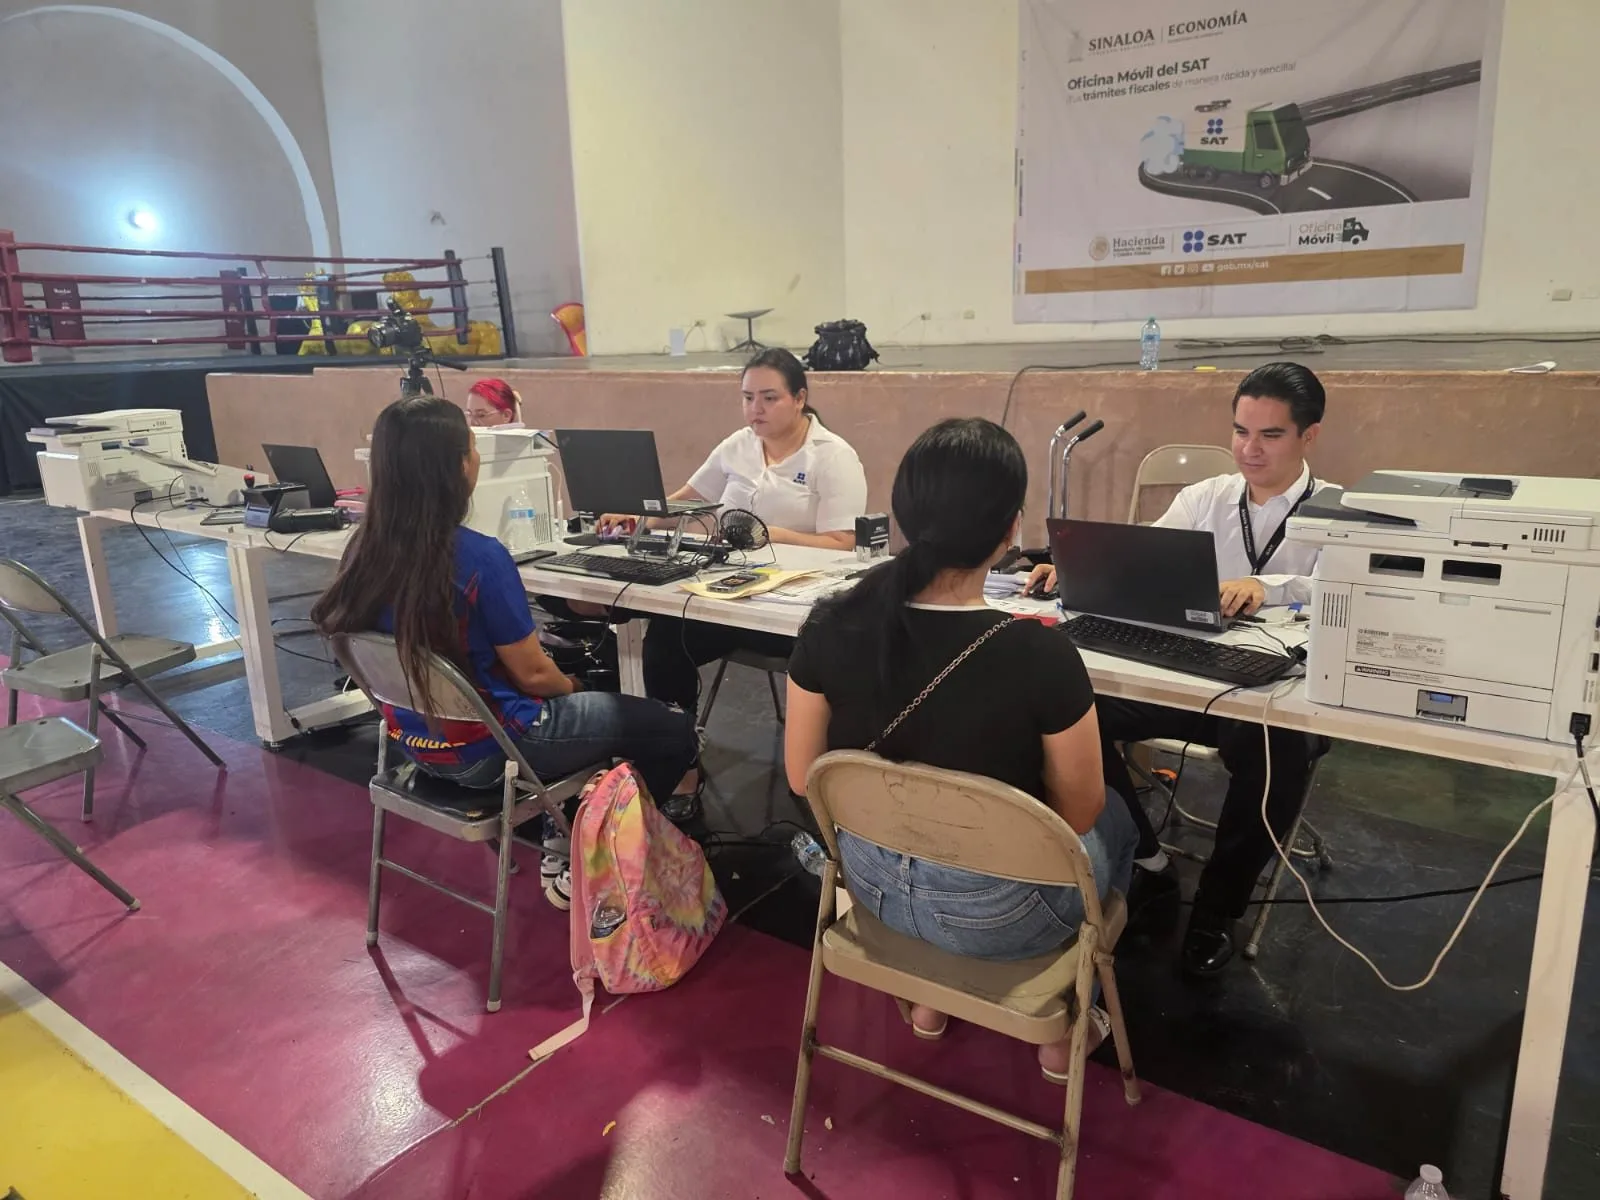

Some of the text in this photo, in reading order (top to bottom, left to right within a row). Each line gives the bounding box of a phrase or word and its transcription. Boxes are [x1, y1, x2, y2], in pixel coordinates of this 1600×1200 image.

[1168, 9, 1248, 37] ECONOMÍA
[1088, 29, 1155, 52] SINALOA
[1067, 57, 1210, 90] Oficina Móvil del SAT
[1083, 88, 1127, 101] trámites
[1129, 81, 1170, 95] fiscales
[1200, 136, 1229, 145] SAT
[1299, 221, 1342, 233] Oficina
[1113, 235, 1165, 247] Hacienda
[1207, 232, 1247, 246] SAT
[1299, 233, 1334, 245] Móvil
